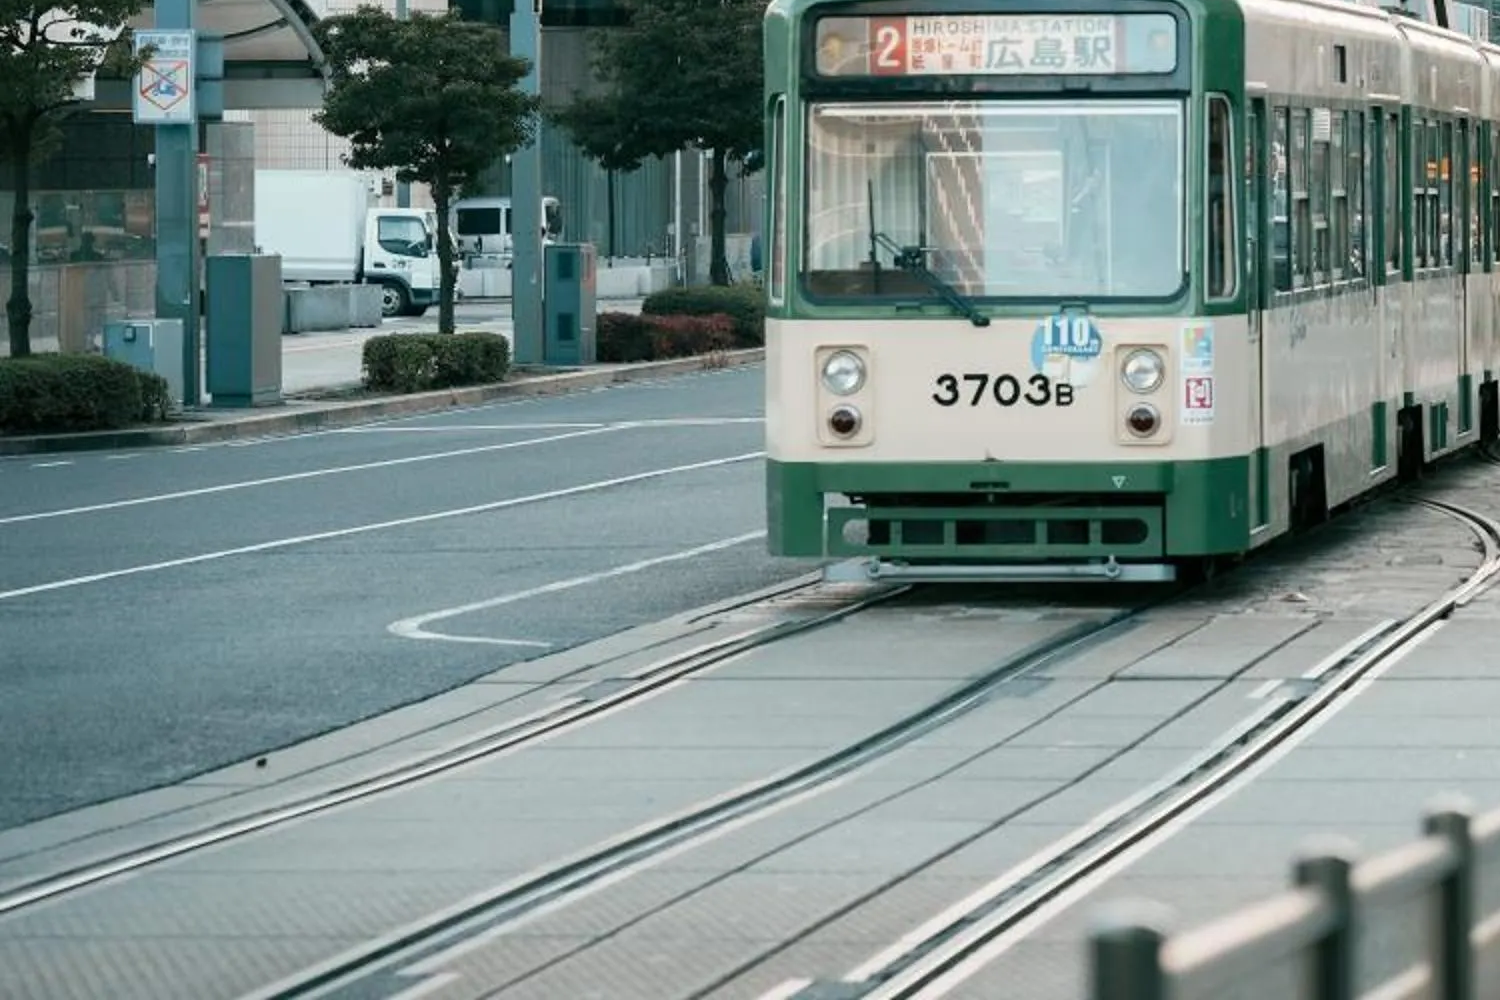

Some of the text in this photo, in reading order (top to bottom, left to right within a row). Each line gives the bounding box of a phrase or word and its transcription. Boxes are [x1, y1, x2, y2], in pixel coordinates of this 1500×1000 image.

[913, 19, 1110, 35] HIROSHIMA STATION
[877, 26, 901, 68] 2
[986, 36, 1112, 69] 広島駅
